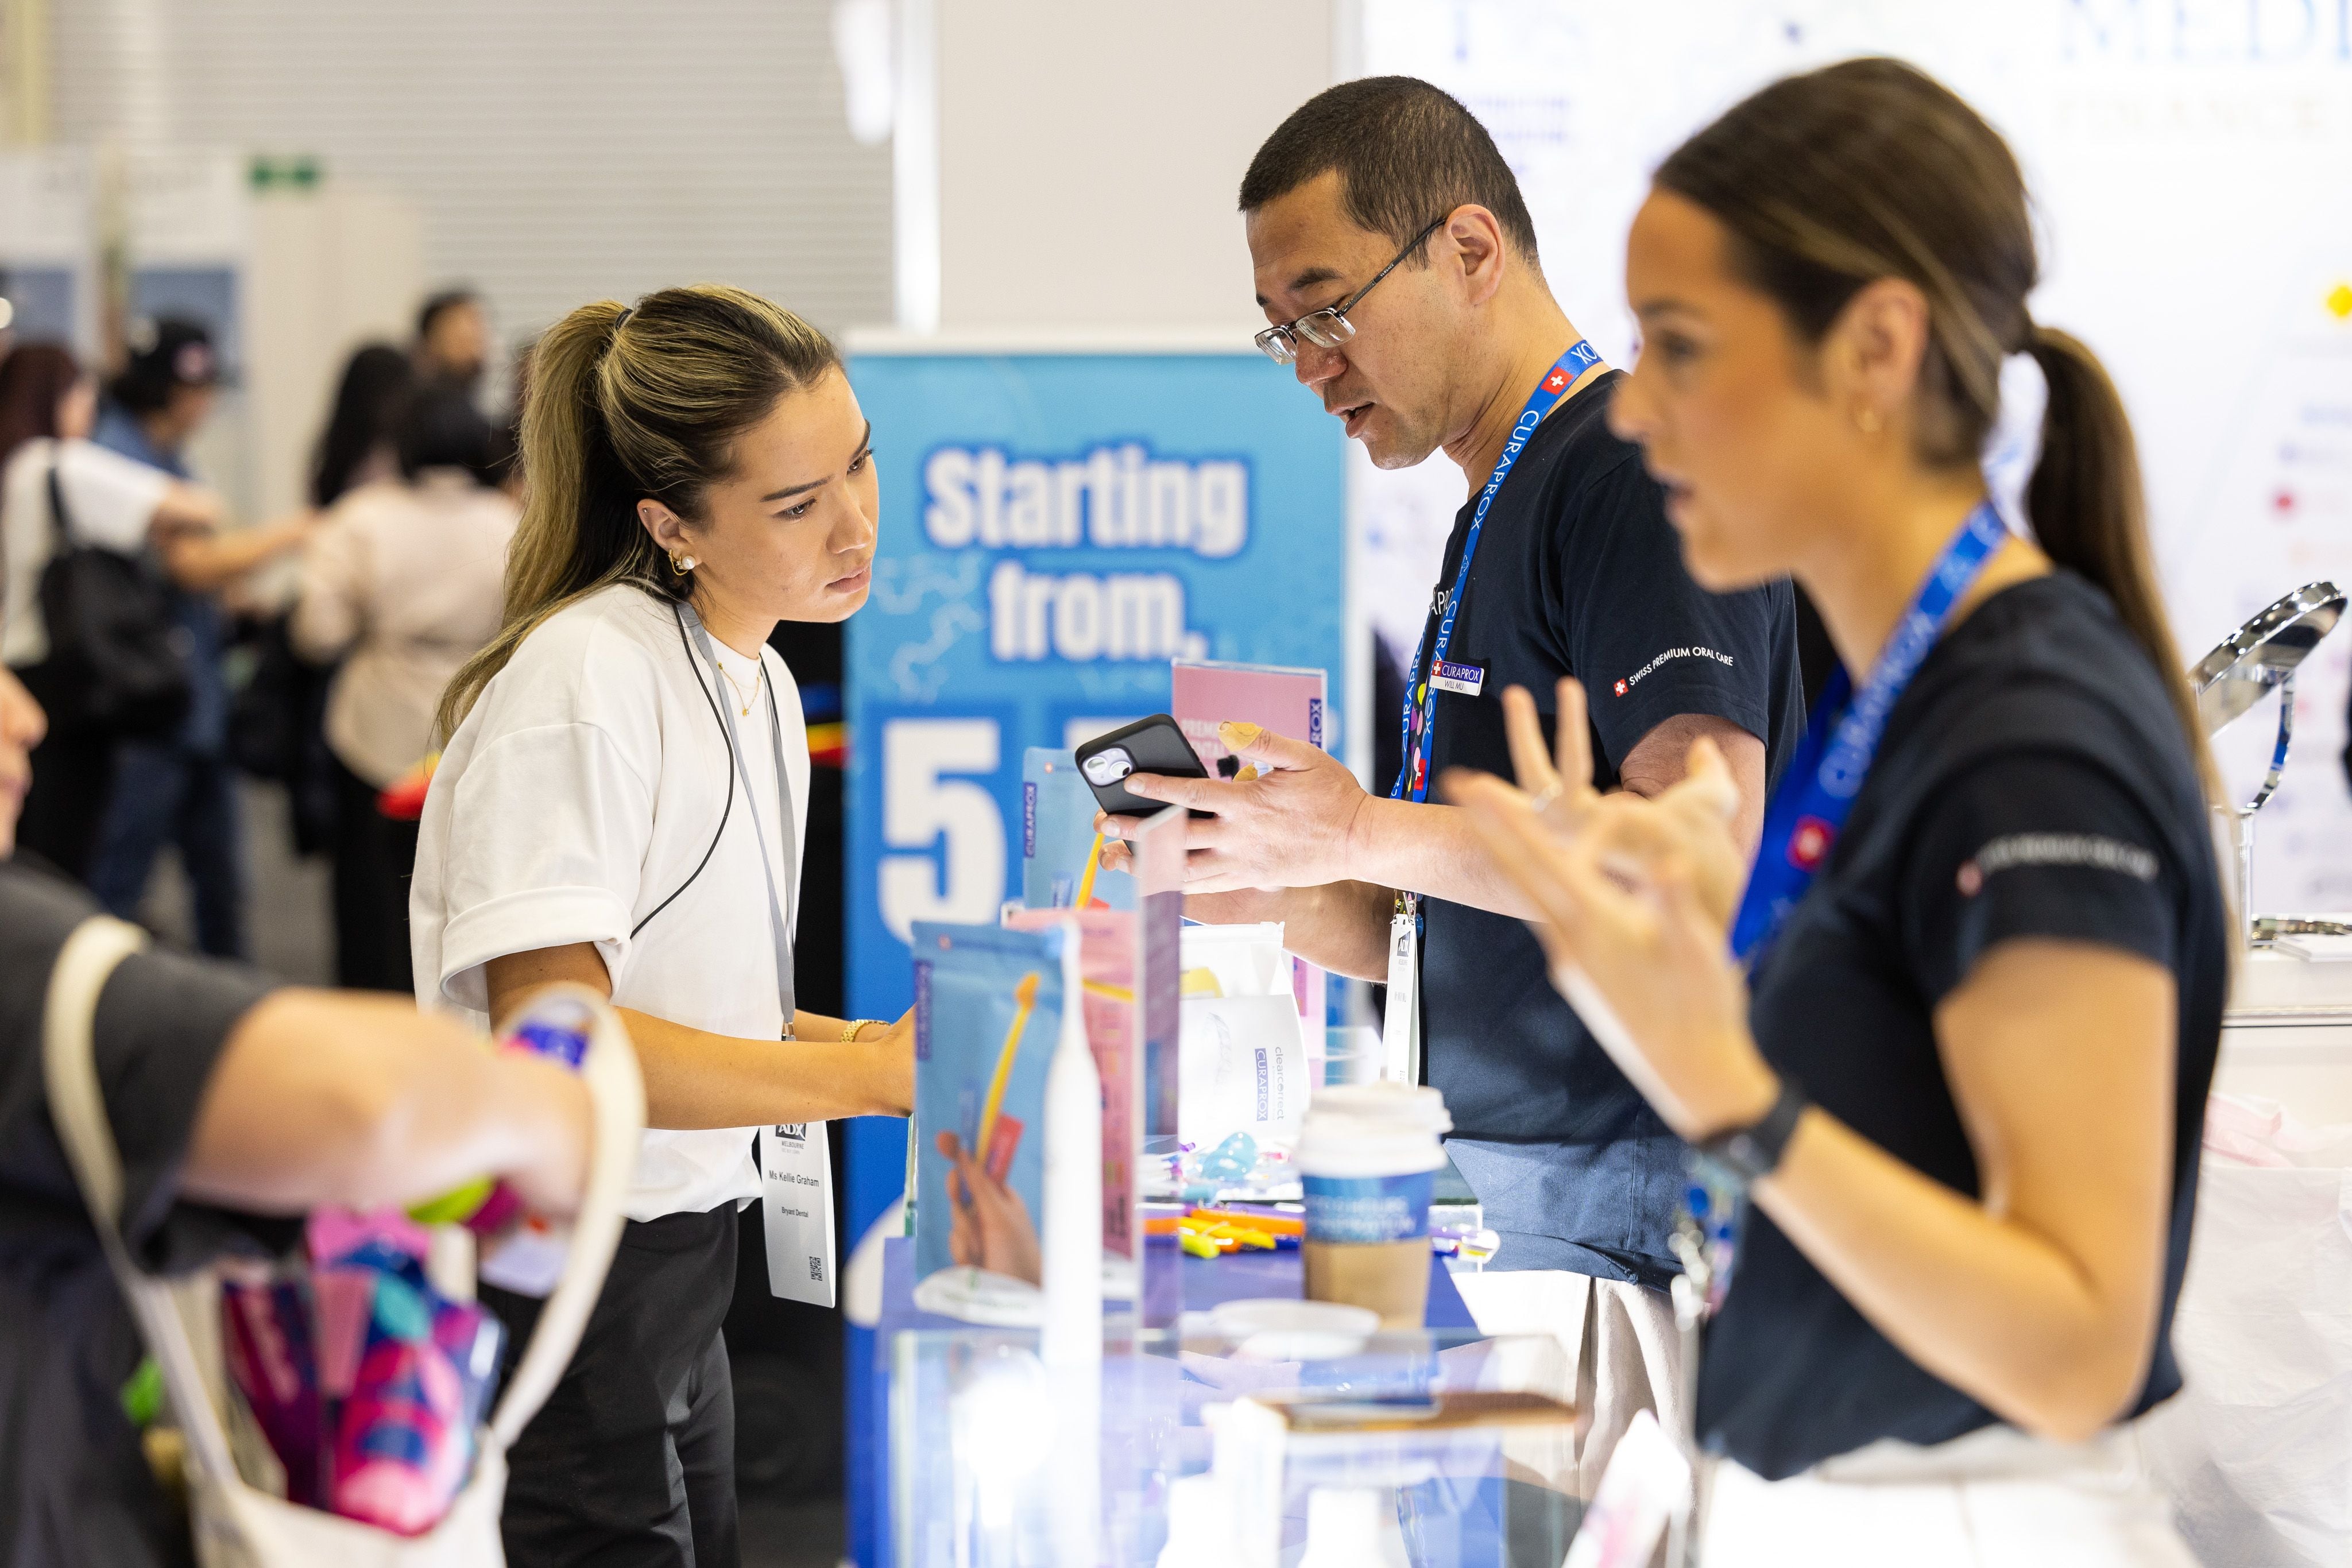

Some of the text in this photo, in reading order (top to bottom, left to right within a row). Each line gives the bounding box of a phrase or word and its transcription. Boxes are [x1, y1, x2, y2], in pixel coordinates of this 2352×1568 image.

[1471, 409, 1539, 530] CURAPROX
[925, 443, 1247, 557] Starting
[1441, 665, 1480, 682] CURAPROX
[1629, 646, 1734, 686] SWISS PREMIUM ORAL CARE
[1444, 679, 1464, 690] WILL MU
[1256, 1050, 1267, 1120] CURAPROX
[1275, 1047, 1284, 1120] clearcorrect
[778, 1123, 806, 1140] ADX
[769, 1170, 819, 1187] Ms Kellie Graham
[782, 1207, 808, 1218] Bryant Dental
